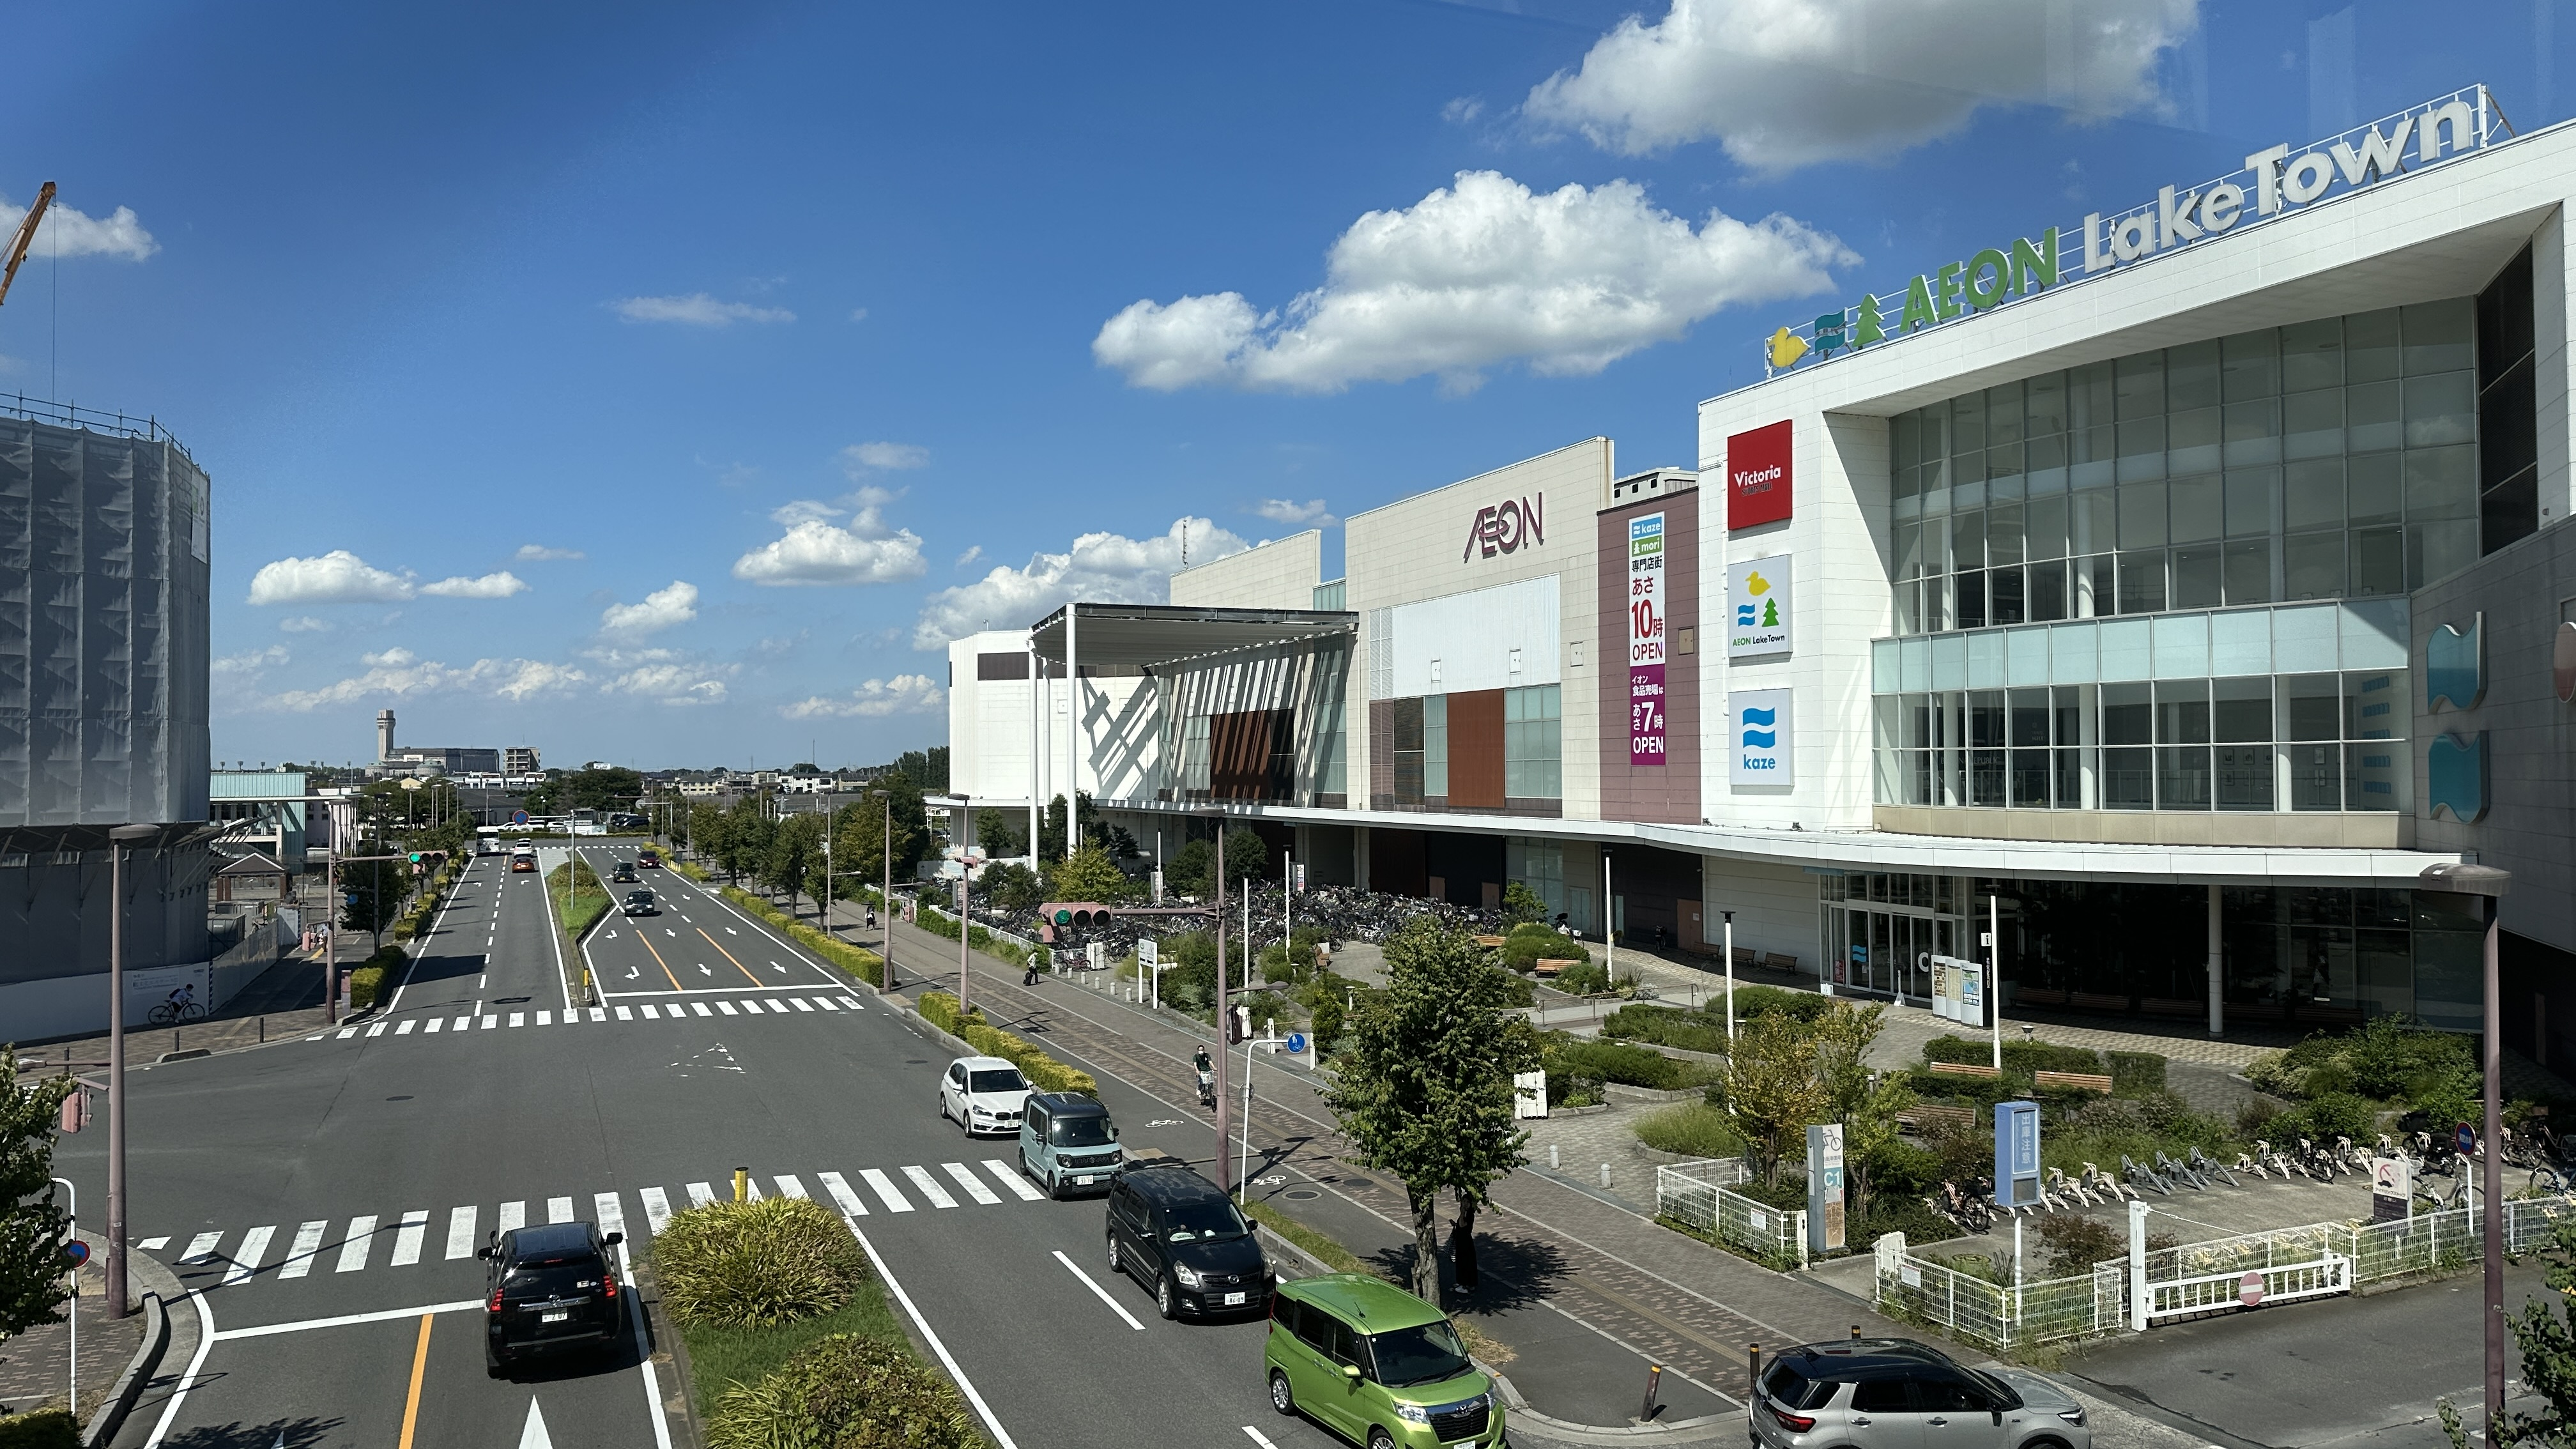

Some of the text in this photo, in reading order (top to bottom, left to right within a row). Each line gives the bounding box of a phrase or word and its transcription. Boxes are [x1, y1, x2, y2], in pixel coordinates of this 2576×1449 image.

[1898, 226, 2059, 334] AEON
[1734, 464, 1781, 487] Victoria
[1742, 482, 1772, 496] SPORTS MALL
[1641, 521, 1661, 534] kaze
[1641, 537, 1660, 553] mori
[1632, 555, 1662, 573] 専門店街
[1632, 575, 1654, 597] あさ
[1631, 599, 1664, 640] 10時
[1732, 636, 1751, 647] AEON
[1632, 641, 1663, 661] OPEN
[1632, 675, 1648, 685] イオン
[1632, 684, 1664, 696] 食品売場は
[1632, 736, 1664, 755] OPEN
[1743, 754, 1776, 770] kaze
[2021, 1112, 2031, 1164] 出庫注意
[1824, 1170, 1840, 1186] C1
